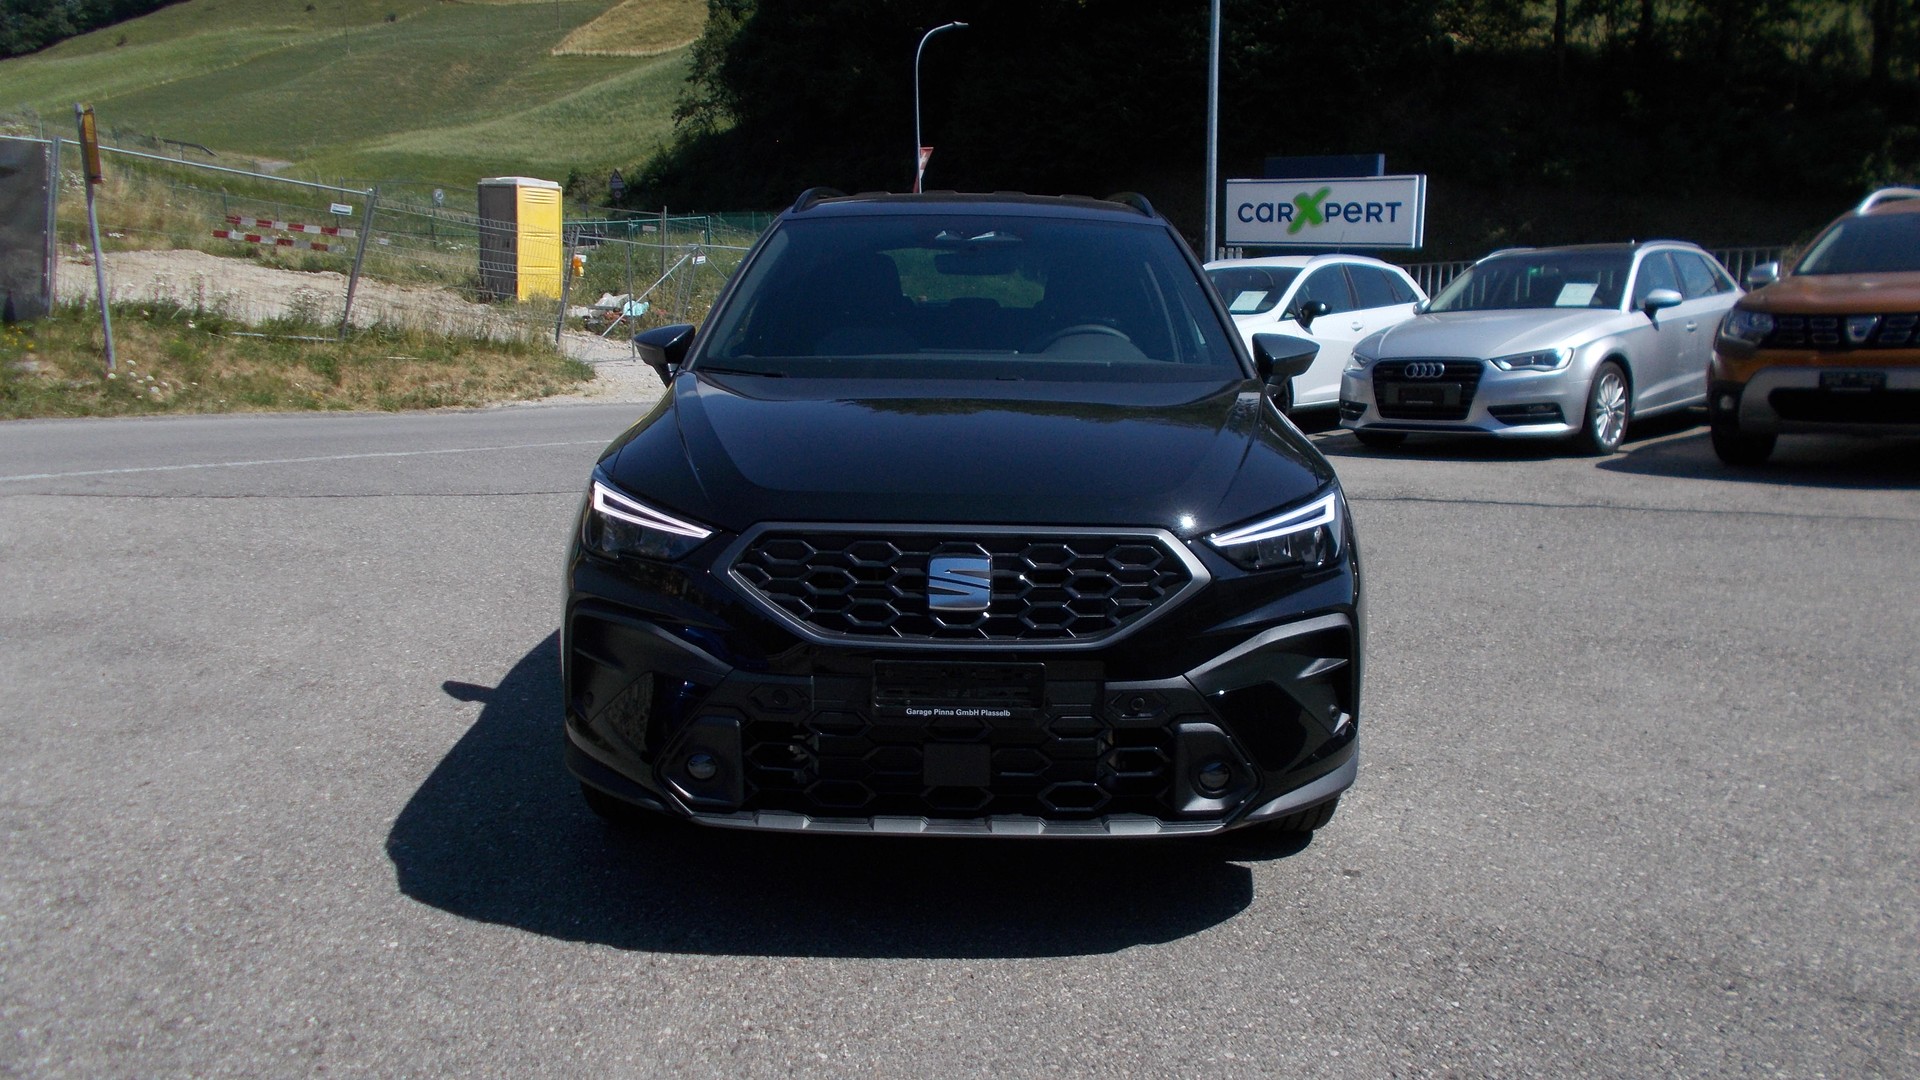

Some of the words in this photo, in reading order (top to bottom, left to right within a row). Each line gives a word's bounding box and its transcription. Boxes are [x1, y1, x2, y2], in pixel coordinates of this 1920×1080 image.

[906, 708, 932, 717] Garage
[933, 708, 954, 716] Pinna
[981, 709, 1010, 717] Plasselb
